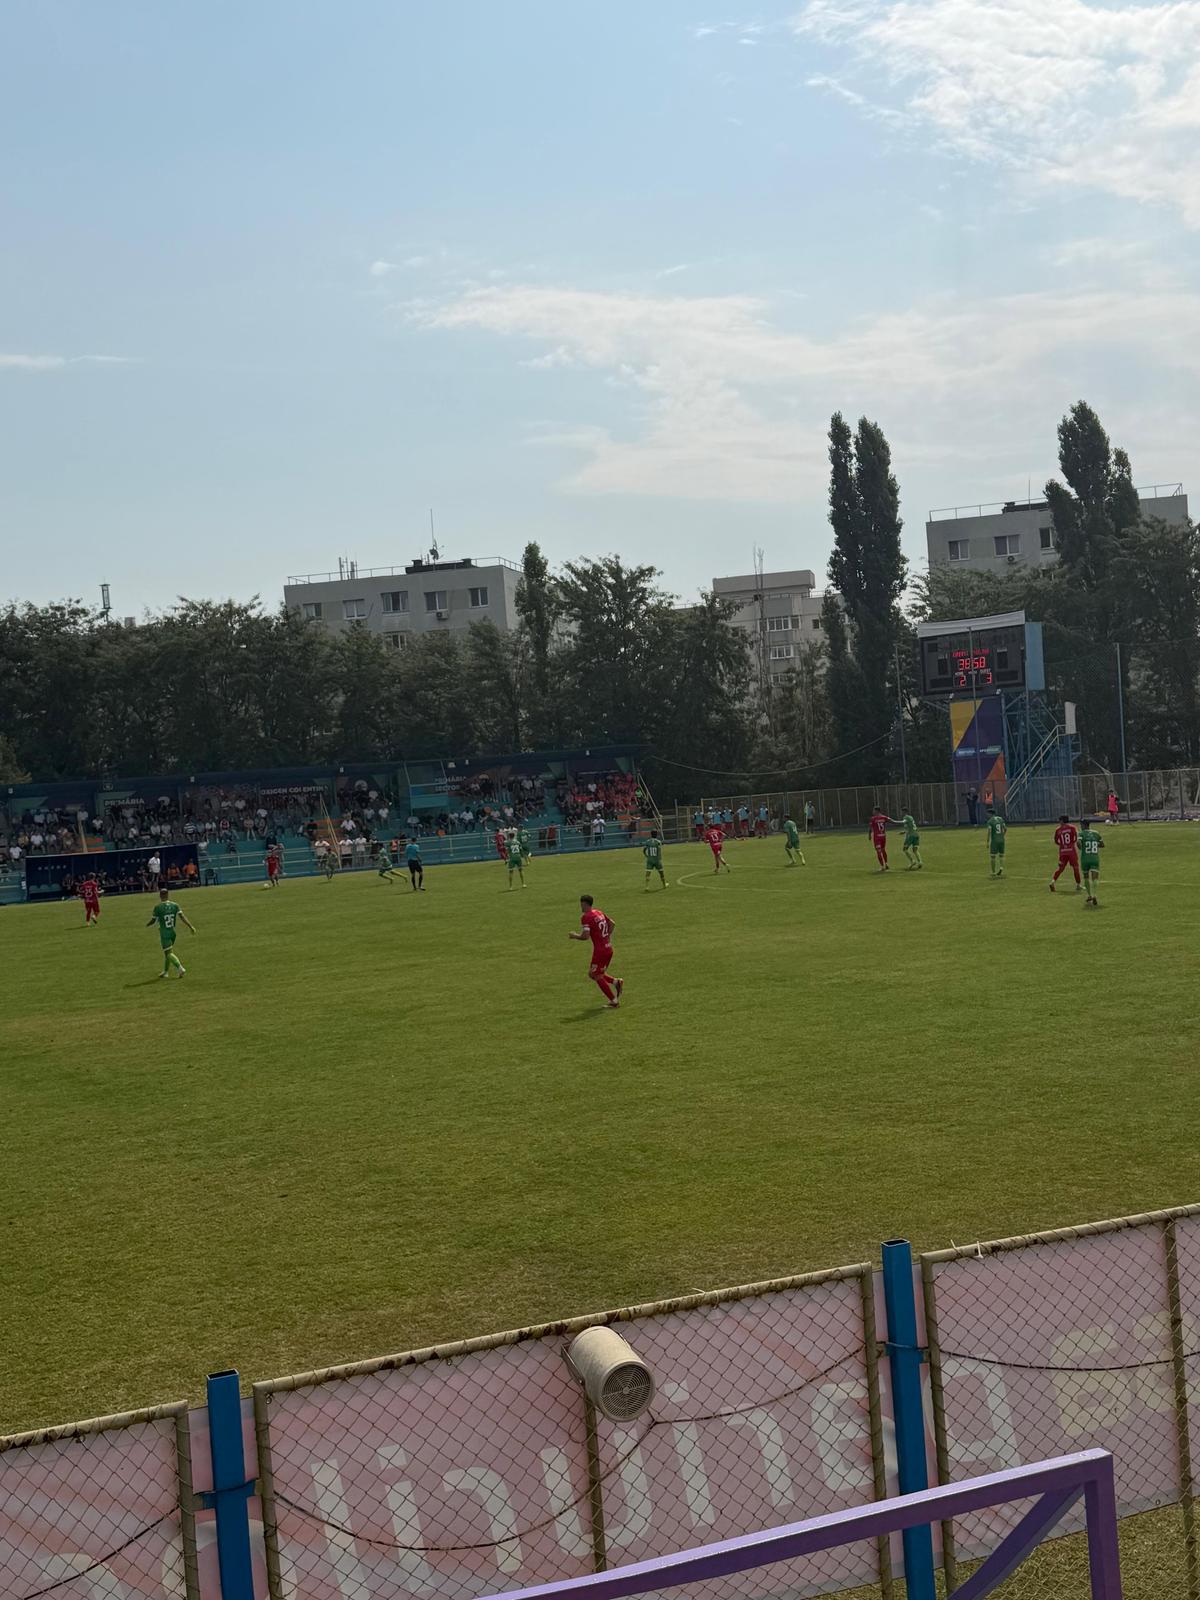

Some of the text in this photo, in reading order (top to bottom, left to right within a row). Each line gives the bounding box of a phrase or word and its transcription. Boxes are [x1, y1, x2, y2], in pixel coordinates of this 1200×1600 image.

[960, 675, 967, 687] 2
[986, 672, 993, 684] 3
[1061, 833, 1071, 845] 18
[649, 847, 657, 857] 10
[1085, 841, 1098, 854] 28
